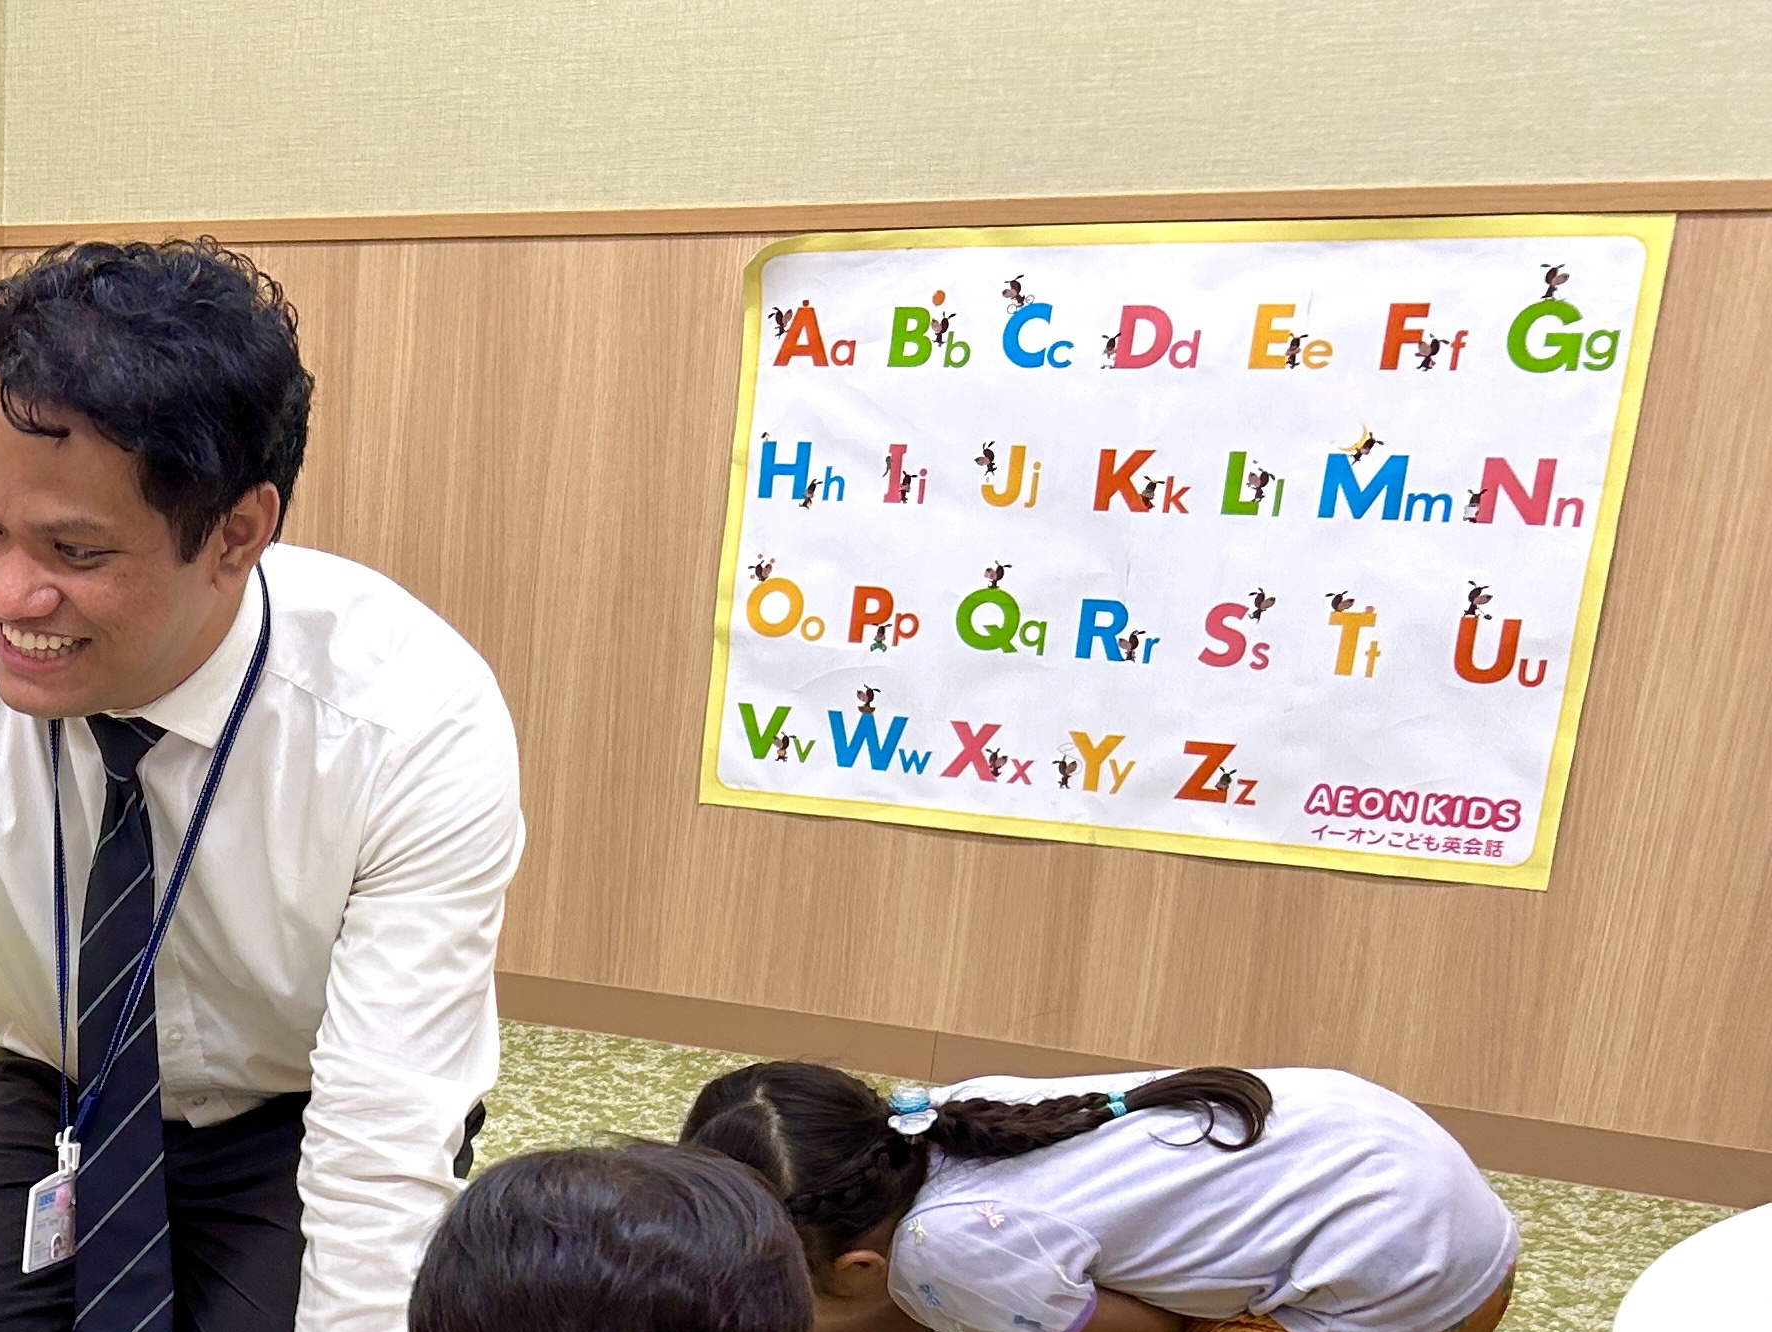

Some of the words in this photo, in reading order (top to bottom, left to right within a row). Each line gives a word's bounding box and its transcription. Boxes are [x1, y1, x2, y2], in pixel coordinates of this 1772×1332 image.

[773, 302, 856, 367] Aa
[887, 306, 971, 369] Bb
[1002, 302, 1074, 369] Cc
[1113, 304, 1201, 369] Dd
[1247, 303, 1333, 370] Ee
[1379, 302, 1468, 371] Ff
[1506, 298, 1621, 373] Gg
[757, 440, 845, 502] Hh
[882, 443, 928, 504] Ii
[980, 444, 1042, 509] Jj
[1092, 449, 1192, 514] Kk
[1220, 450, 1285, 517] Ll
[1317, 453, 1452, 523] Mm
[1475, 456, 1585, 528] Nn
[746, 577, 826, 642] Oo
[848, 585, 920, 648] Pp
[955, 587, 1047, 656] Qq
[1074, 598, 1160, 664] Rr
[1197, 603, 1270, 671] Ss
[1328, 610, 1381, 679] Tt
[1453, 617, 1548, 687] Uu
[738, 702, 816, 764] Vv
[827, 710, 932, 775] Ww
[940, 719, 1034, 786] Xx
[1068, 730, 1136, 795] Yy
[1174, 740, 1259, 806] Zz
[1305, 783, 1420, 828] AEON
[1420, 794, 1521, 832] KIDS
[1311, 824, 1504, 858] イーオンこども英会話
